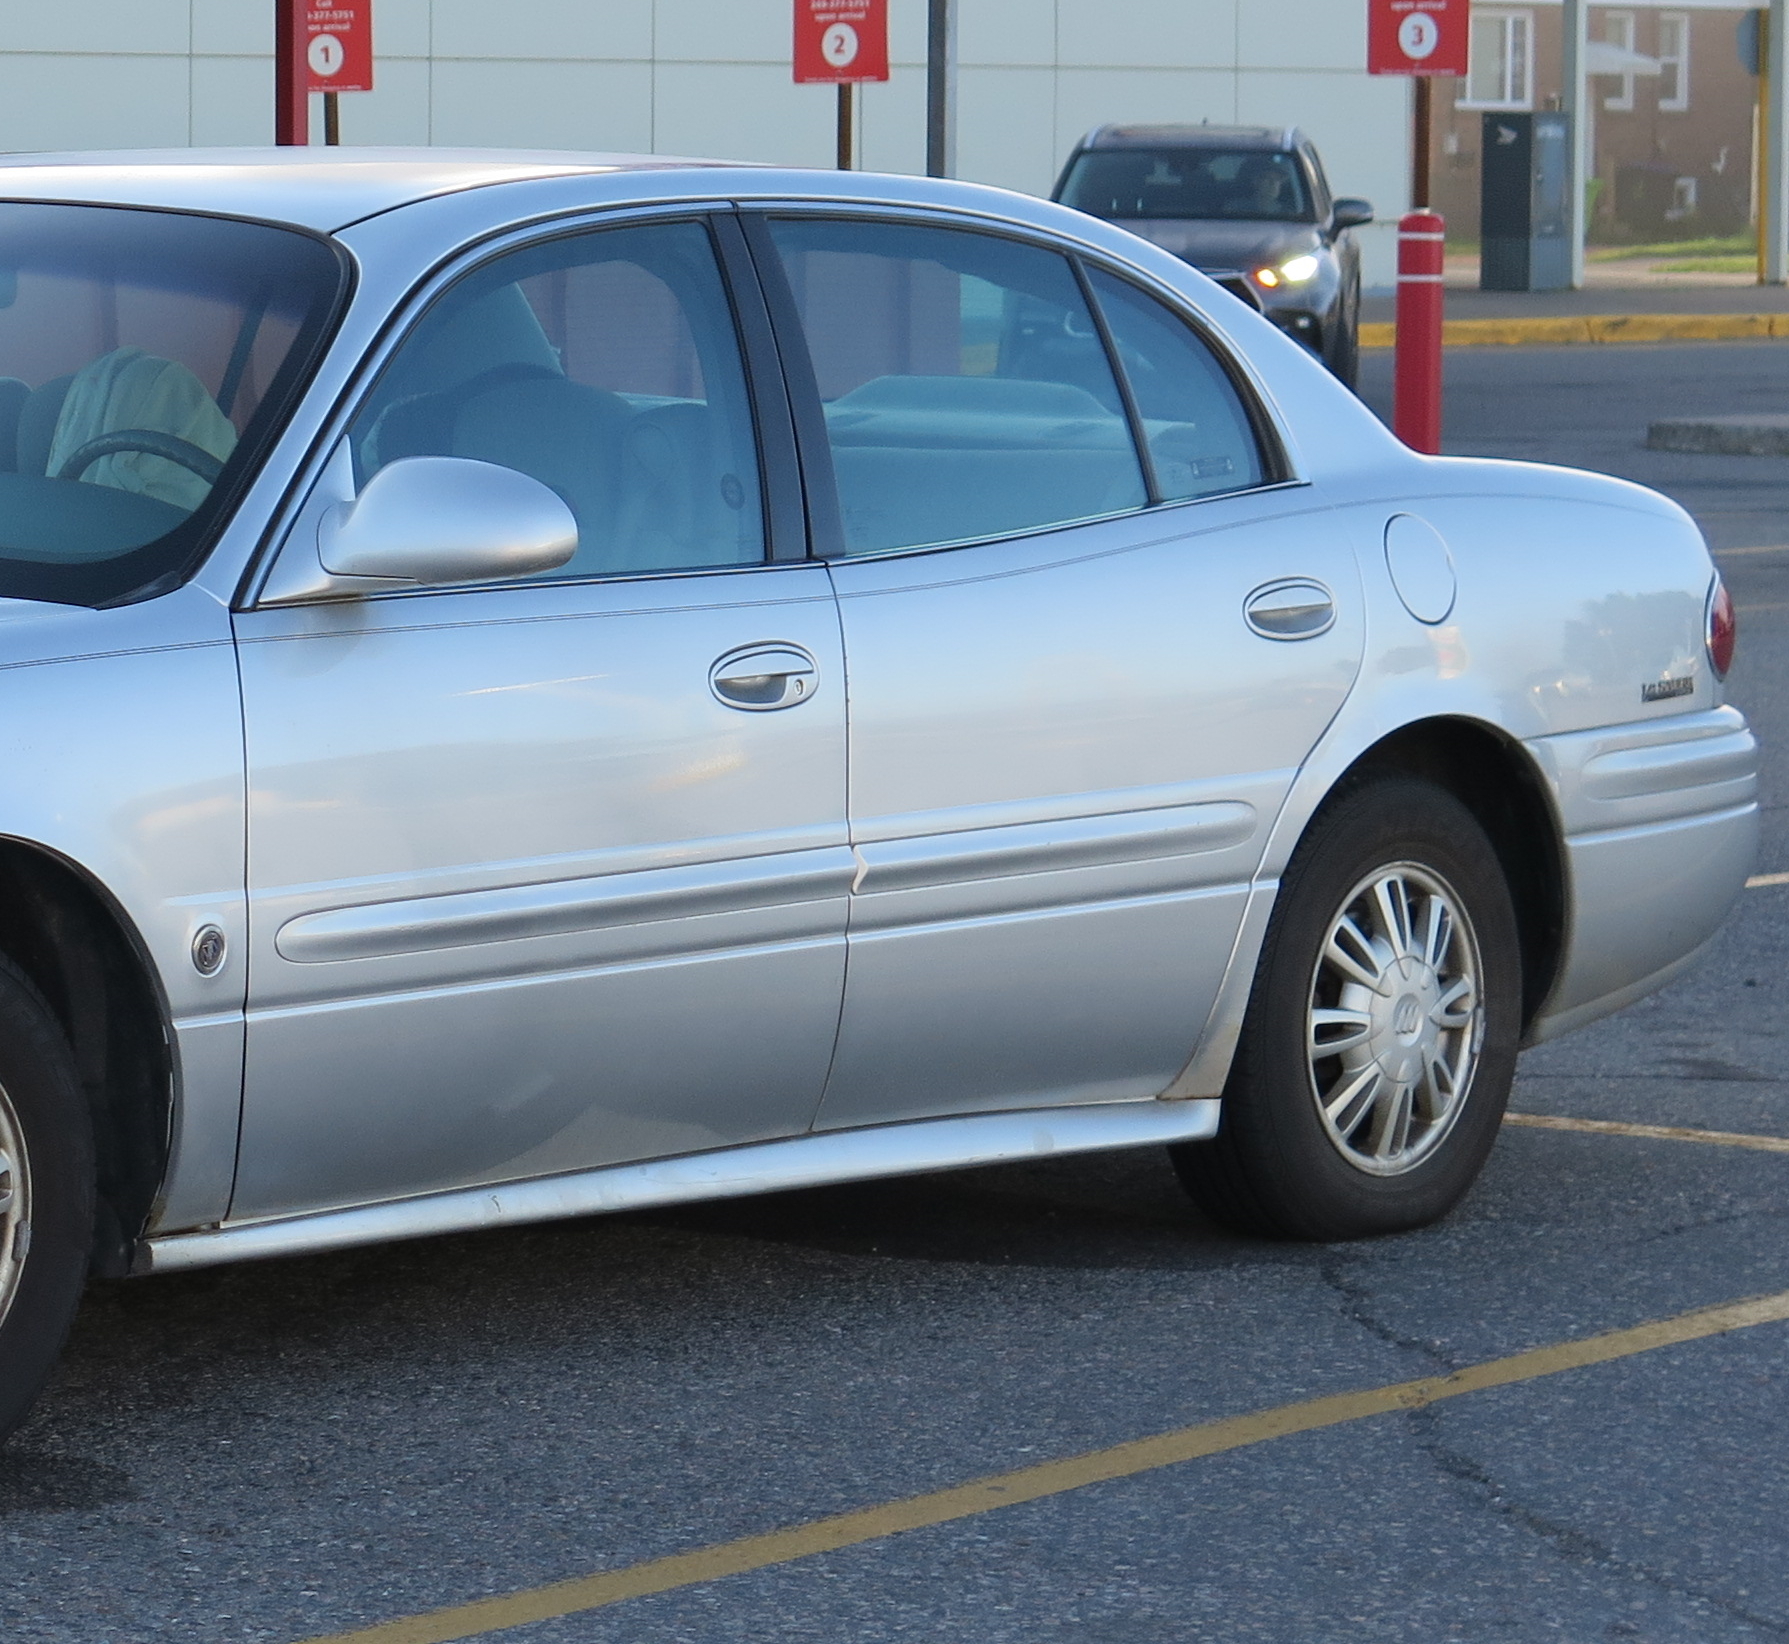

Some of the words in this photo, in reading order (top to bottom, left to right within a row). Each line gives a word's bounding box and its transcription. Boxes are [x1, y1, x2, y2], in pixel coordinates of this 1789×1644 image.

[834, 34, 845, 54] 2
[1412, 24, 1423, 46] 3
[320, 45, 329, 63] 1
